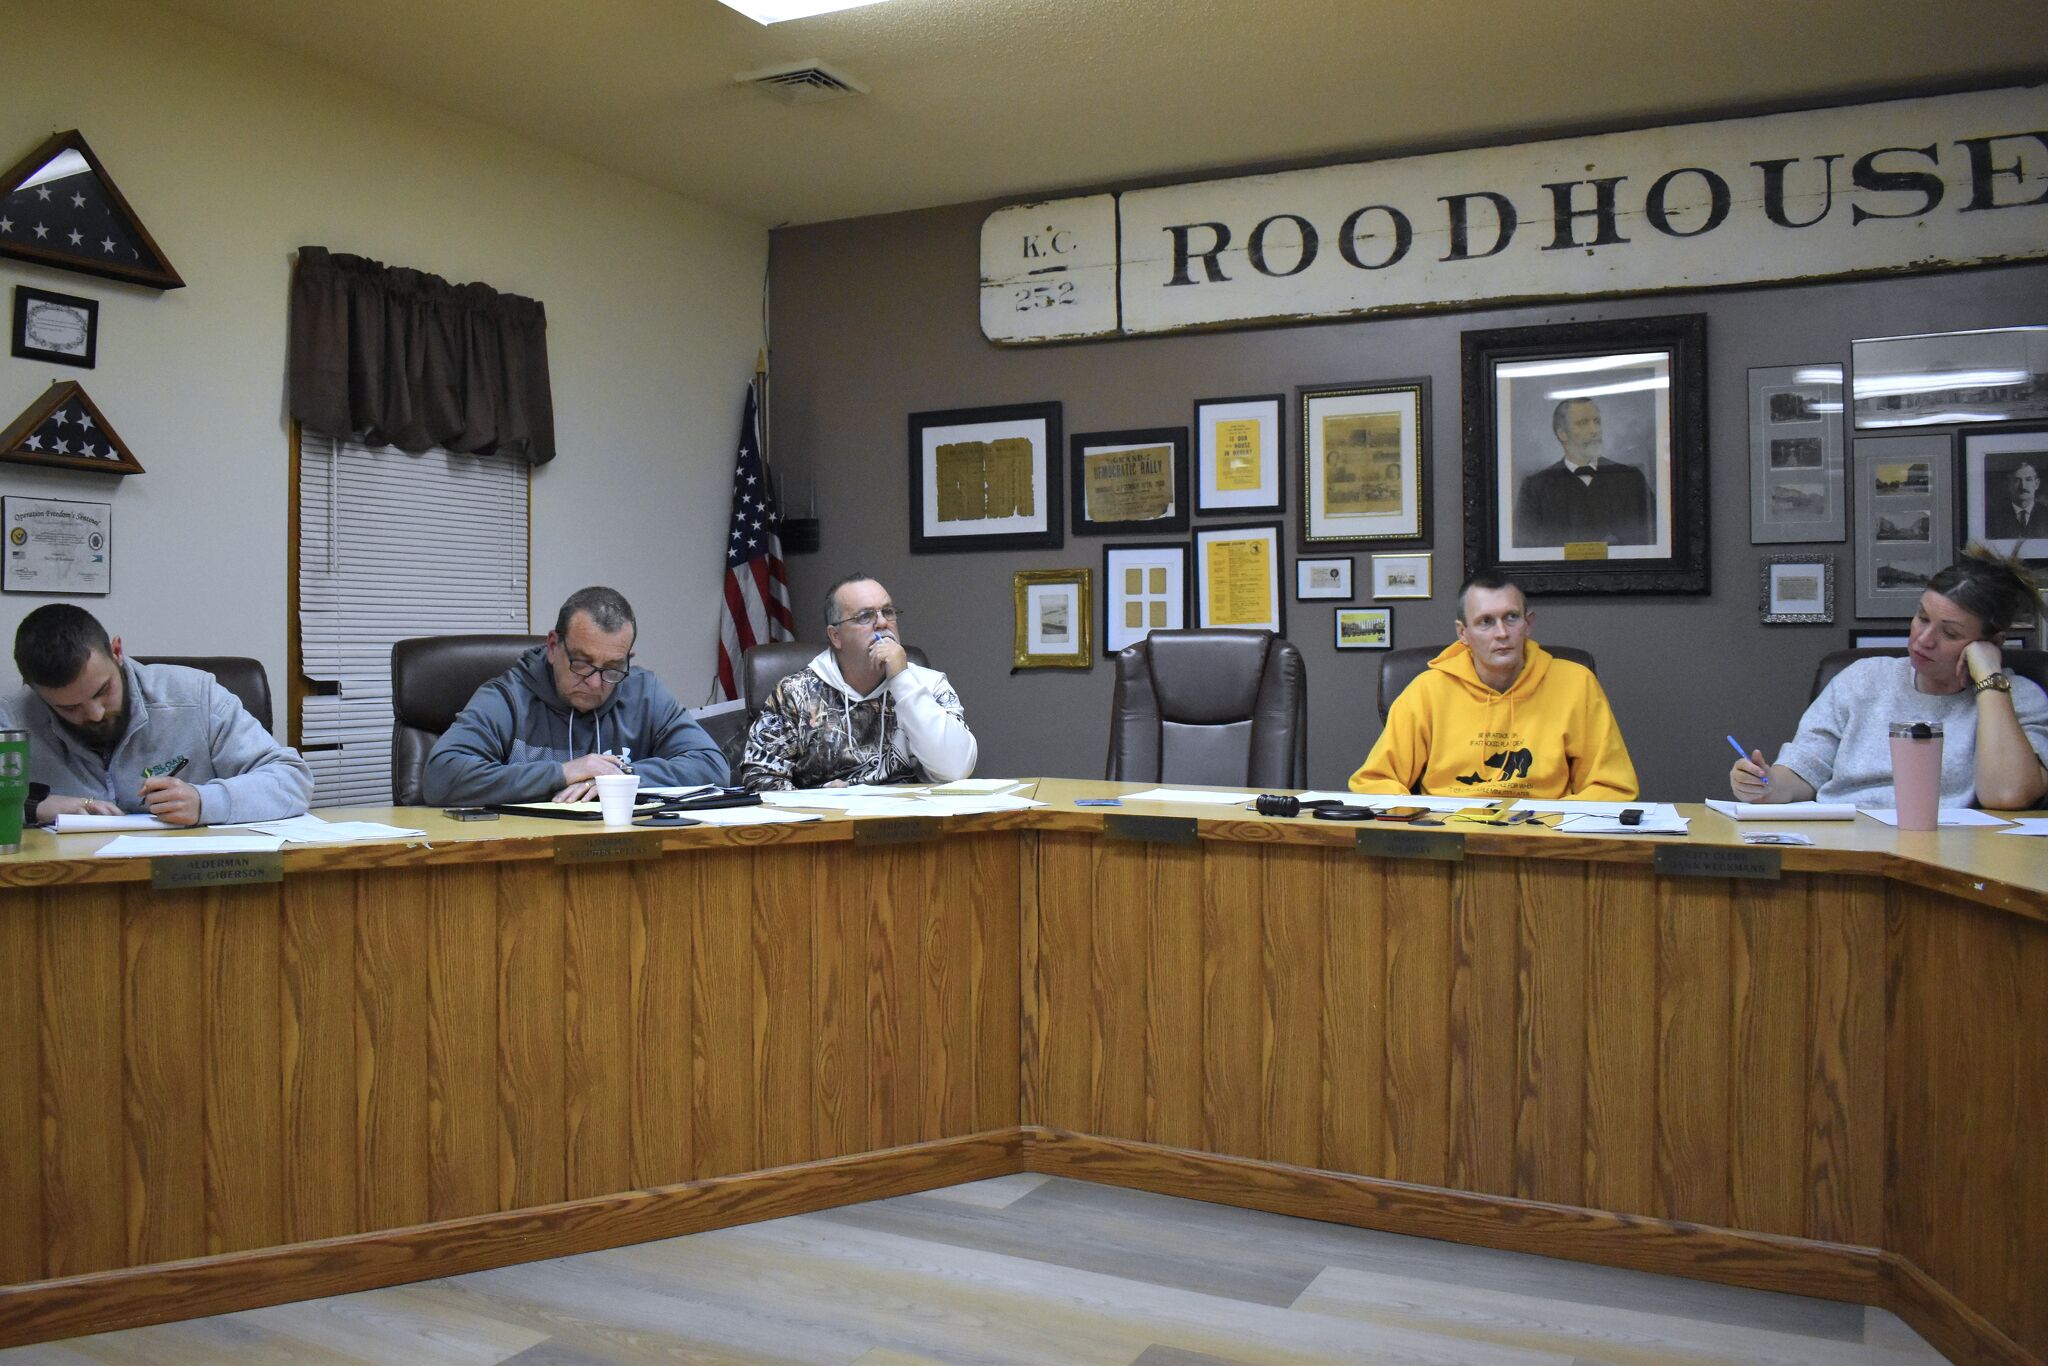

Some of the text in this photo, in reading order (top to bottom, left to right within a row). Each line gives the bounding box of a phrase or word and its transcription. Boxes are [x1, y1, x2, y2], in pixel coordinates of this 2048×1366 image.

[1162, 131, 2048, 287] ROODHOUSE
[1140, 460, 1162, 475] RALLY
[14, 511, 45, 521] Operation
[188, 857, 250, 869] ALDERMAN
